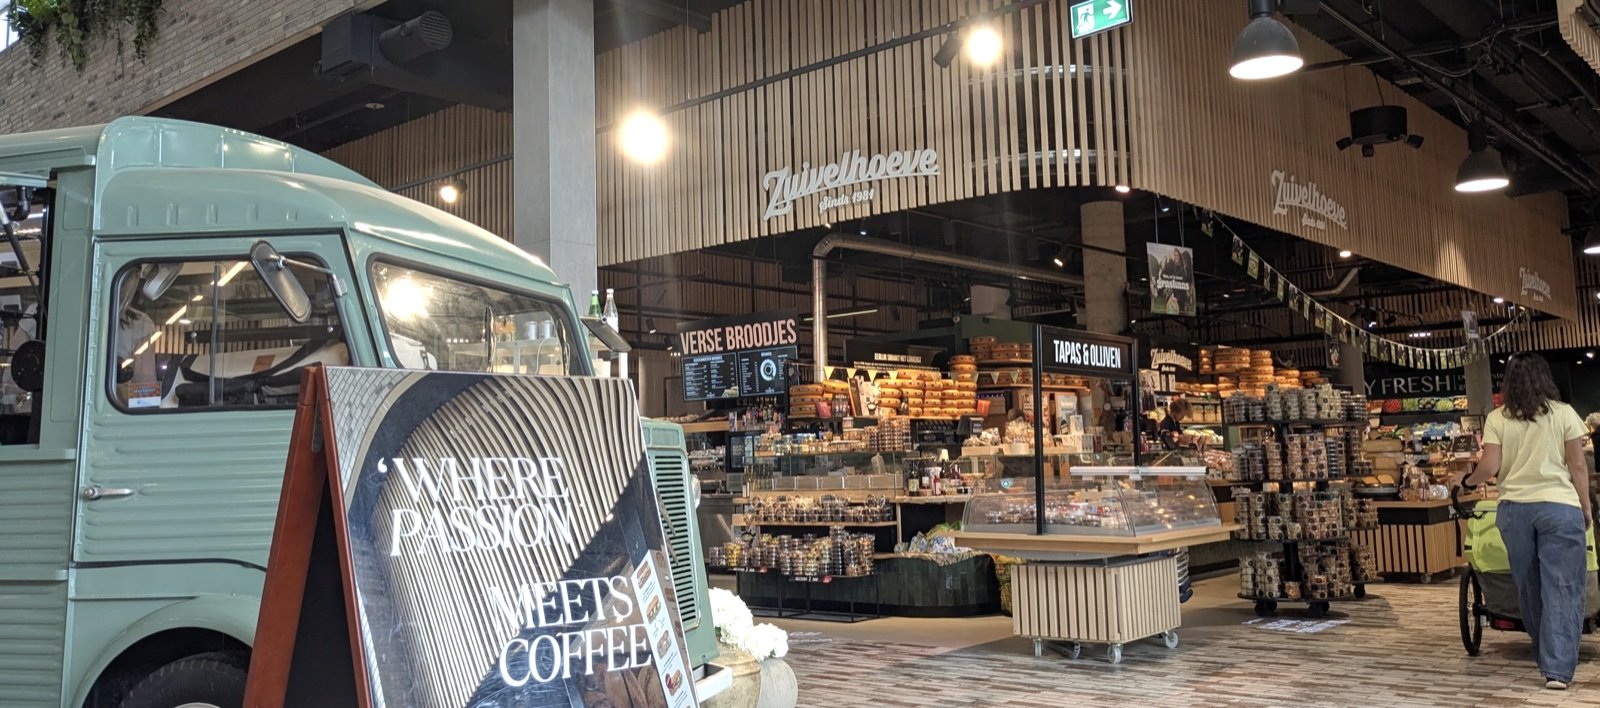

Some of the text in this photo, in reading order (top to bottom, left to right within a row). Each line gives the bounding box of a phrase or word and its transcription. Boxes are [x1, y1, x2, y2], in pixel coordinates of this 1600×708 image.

[763, 148, 940, 221] Zuivelhoeve
[819, 188, 874, 213] Sinds 1981
[1271, 169, 1348, 230] Zuivelhoeve
[680, 318, 797, 355] VERSE BROODJES
[1053, 339, 1121, 369] TAPAS & OLIJVEN
[1381, 374, 1451, 395] FRESH
[390, 501, 575, 557] PASSION
[489, 575, 634, 635] MEETS
[499, 624, 653, 687] COFFEE
